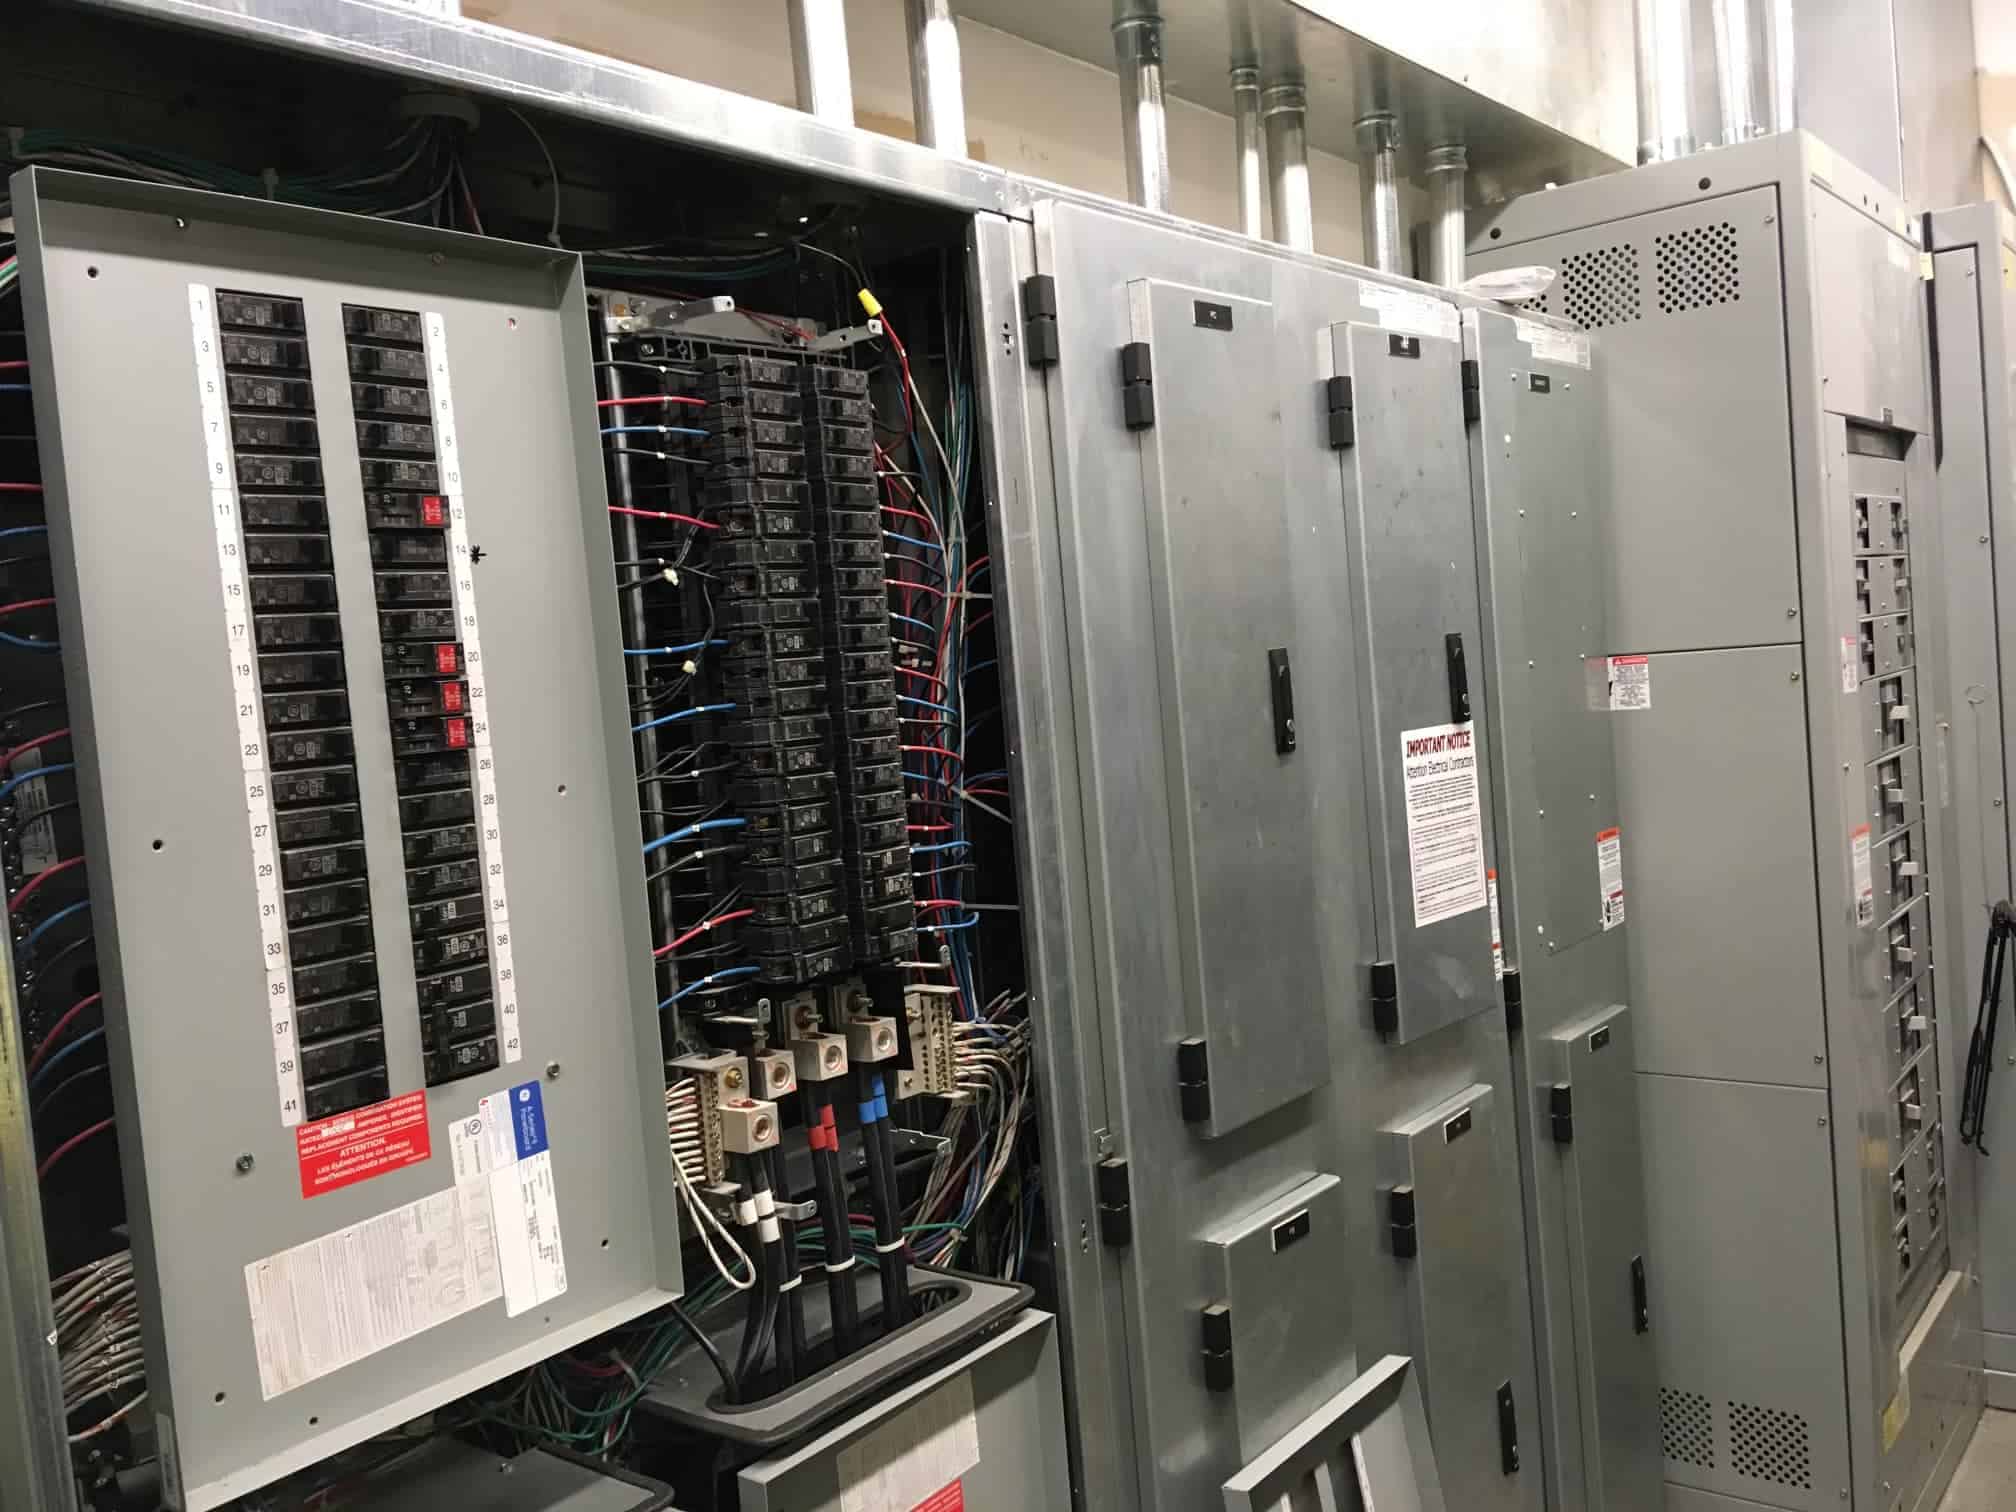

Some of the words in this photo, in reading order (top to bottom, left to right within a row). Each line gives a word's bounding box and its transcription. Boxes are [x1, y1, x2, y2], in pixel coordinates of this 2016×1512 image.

[198, 300, 203, 310] 1
[433, 326, 440, 337] 2
[202, 340, 209, 352] 3
[436, 363, 444, 373] 4
[207, 380, 214, 392] 5
[441, 399, 448, 409] 6
[210, 421, 218, 433] 7
[445, 436, 452, 447] 8
[215, 462, 224, 475] 9
[447, 472, 458, 483] 10
[218, 503, 230, 515] 11
[451, 508, 463, 519] 12
[224, 543, 237, 556] 13
[455, 544, 467, 555] 14
[228, 584, 240, 595] 15
[459, 580, 471, 591] 16
[463, 615, 475, 627] 18
[232, 624, 244, 635] 17
[468, 651, 479, 662] 20
[237, 664, 250, 676] 19
[472, 688, 483, 698] 22
[241, 704, 252, 716] 21
[475, 723, 486, 733] 24
[1407, 735, 1446, 758] IMPORTANT
[1447, 730, 1471, 751] NOTICE
[245, 744, 259, 756] 23
[480, 759, 491, 770] 26
[250, 785, 264, 797] 25
[484, 794, 494, 805] 28
[254, 825, 268, 837] 27
[487, 829, 497, 840] 30
[259, 864, 272, 876] 29
[490, 864, 501, 875] 32
[263, 904, 275, 916] 31
[494, 899, 504, 910] 34
[497, 934, 508, 946] 36
[267, 942, 281, 955] 33
[501, 969, 512, 980] 38
[272, 982, 285, 995] 35
[504, 1004, 515, 1014] 40
[275, 1021, 288, 1034] 37
[506, 1038, 518, 1049] 42
[280, 1060, 293, 1073] 39
[284, 1100, 296, 1112] 41
